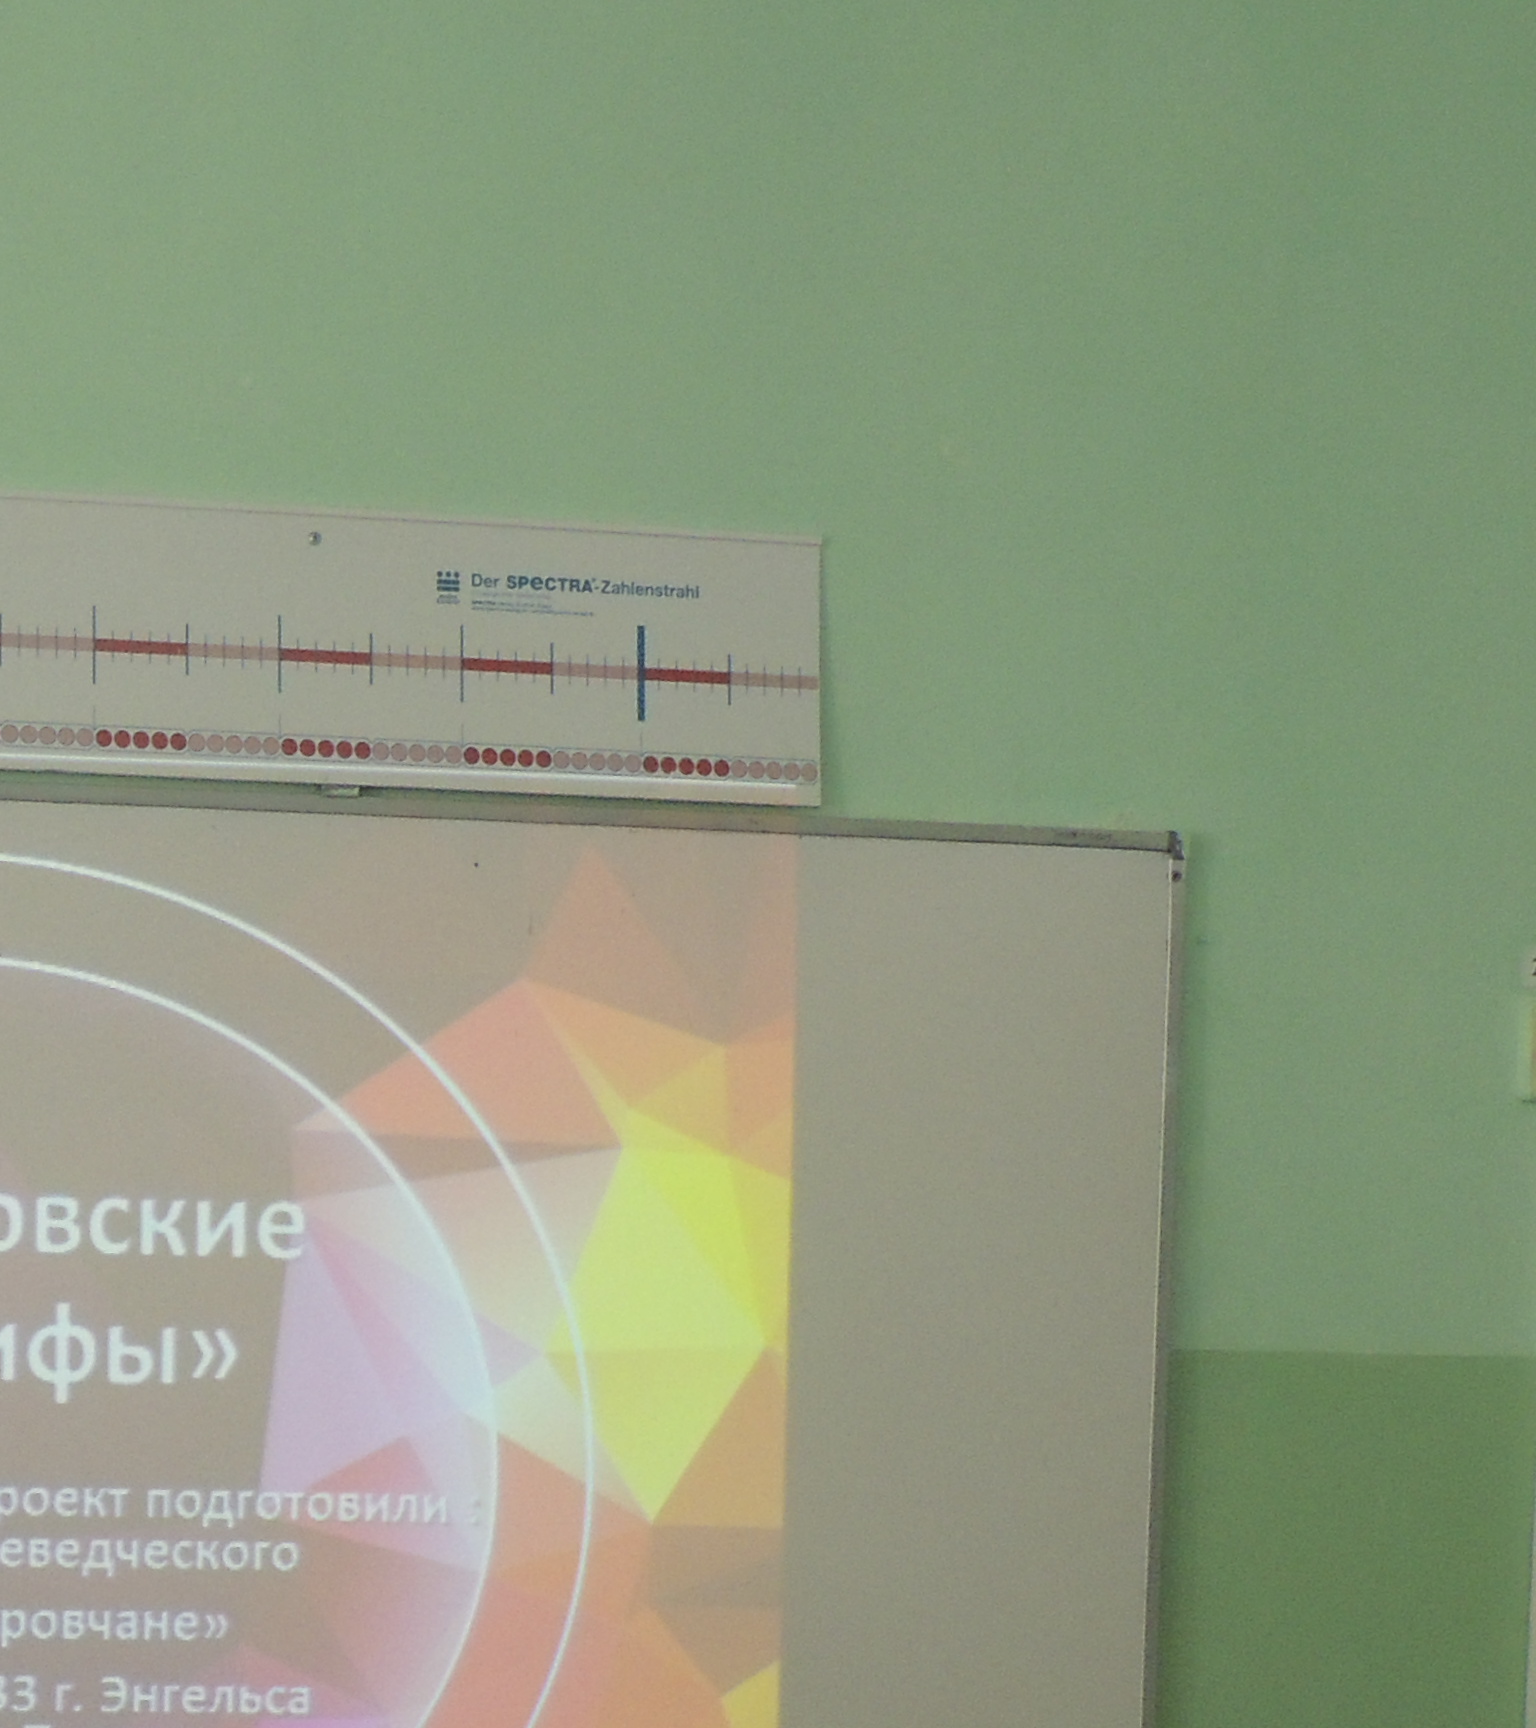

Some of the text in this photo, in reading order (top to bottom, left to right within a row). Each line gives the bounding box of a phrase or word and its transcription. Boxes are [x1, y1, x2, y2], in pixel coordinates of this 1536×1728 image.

[471, 573, 501, 588] Der
[53, 1683, 82, 1713] г.
[100, 1676, 313, 1715] Энгельса
